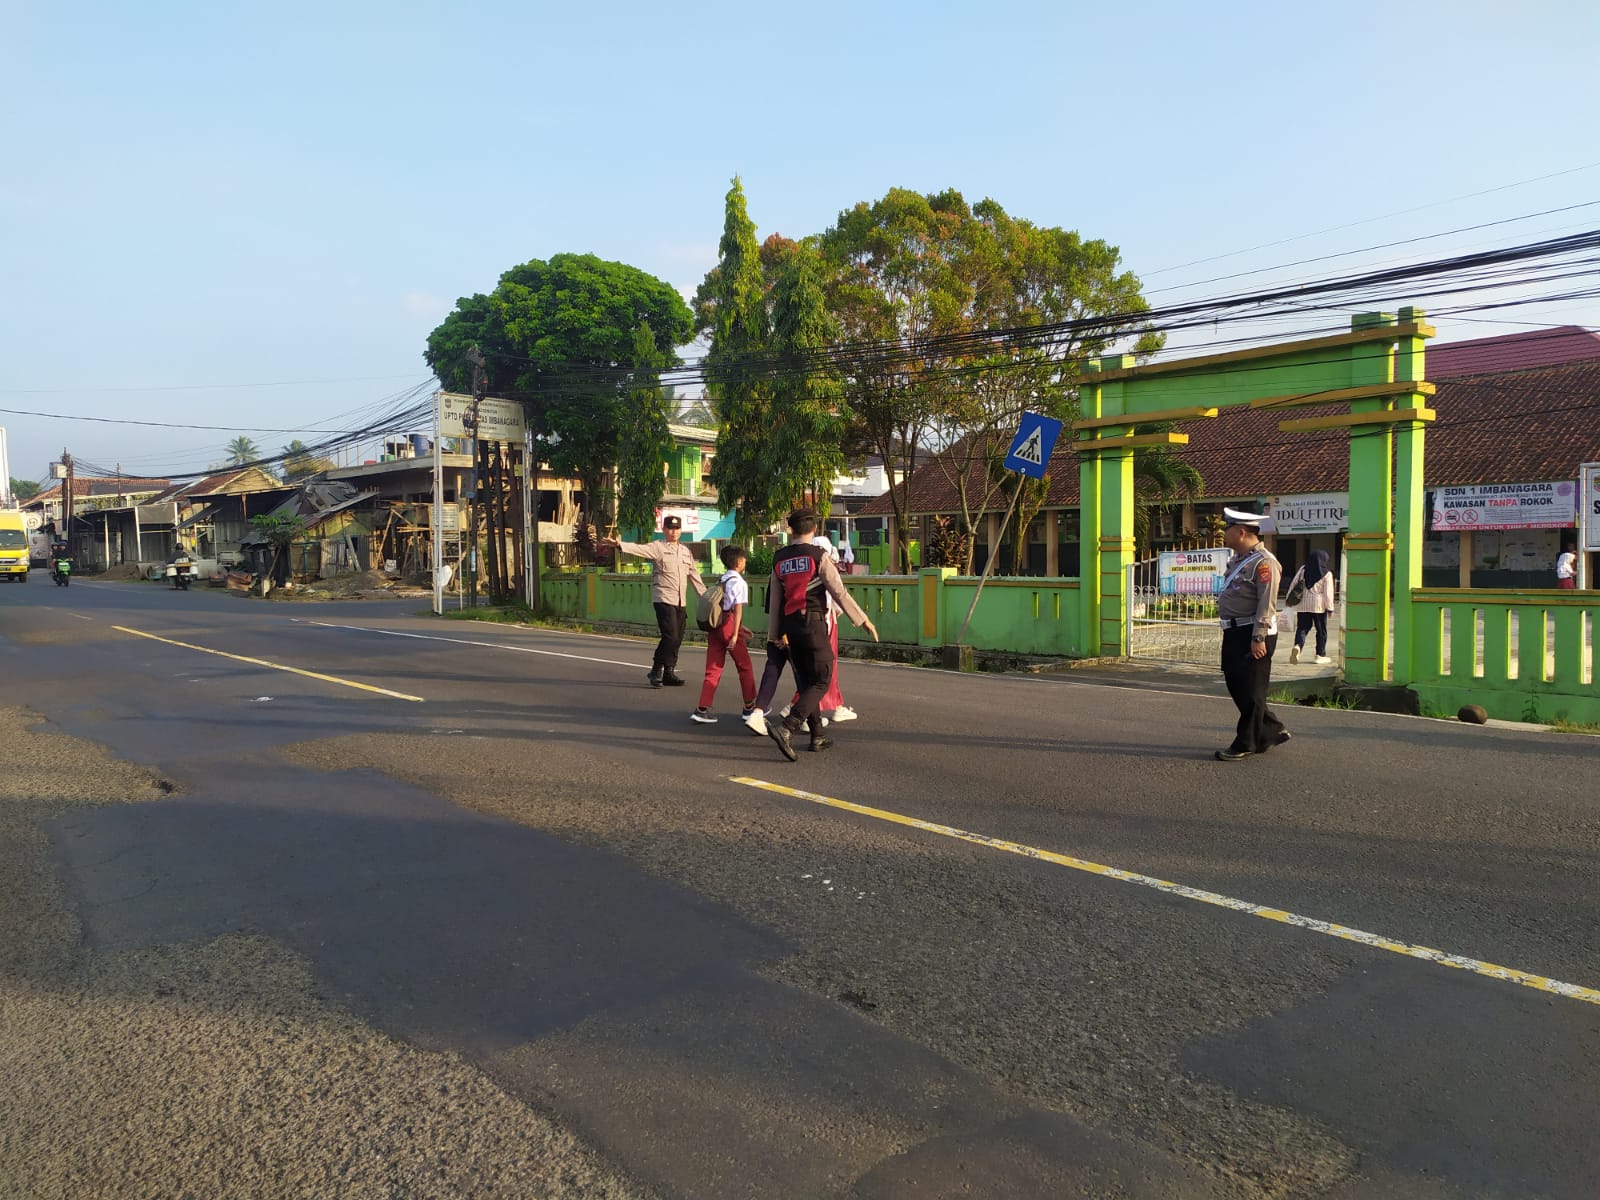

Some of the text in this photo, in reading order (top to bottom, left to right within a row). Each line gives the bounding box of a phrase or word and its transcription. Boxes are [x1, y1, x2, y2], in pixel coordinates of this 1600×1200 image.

[1444, 488, 1466, 496] SDN
[1479, 484, 1553, 495] IMBANAGARA
[1444, 497, 1553, 509] KAWASAN TANPA ROKOK
[1276, 508, 1343, 522] IDUL FITRI
[1187, 554, 1212, 563] BATAS
[780, 558, 809, 574] POLISI
